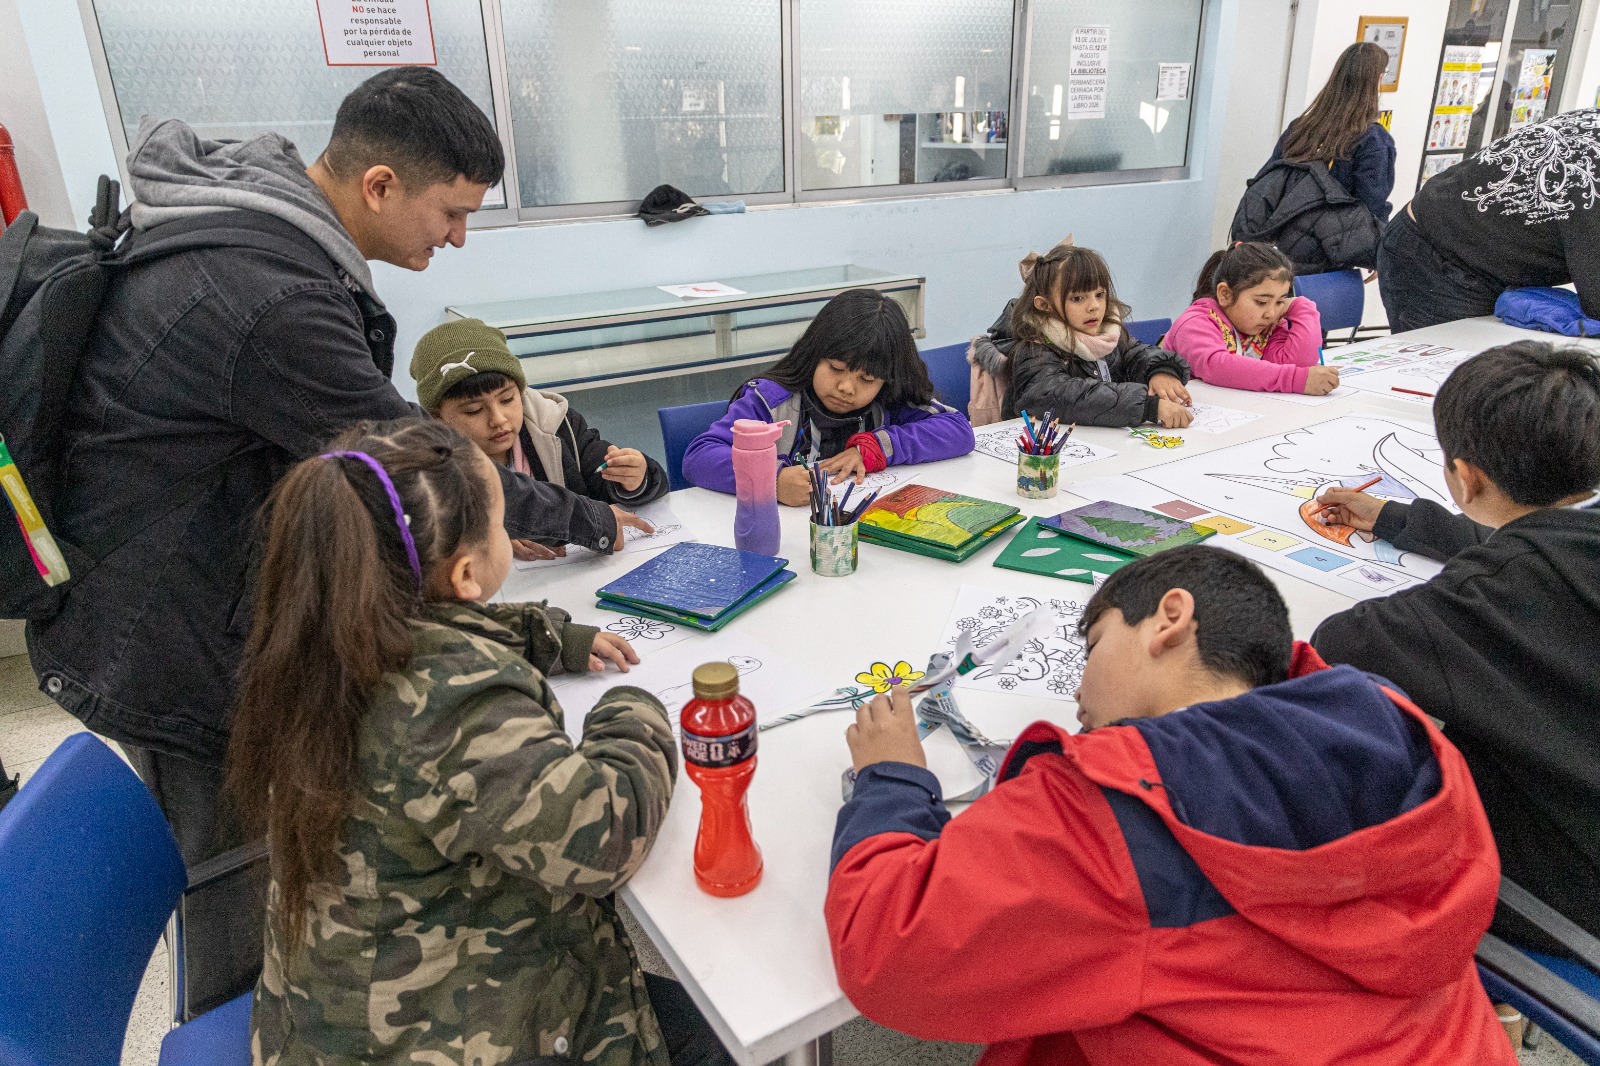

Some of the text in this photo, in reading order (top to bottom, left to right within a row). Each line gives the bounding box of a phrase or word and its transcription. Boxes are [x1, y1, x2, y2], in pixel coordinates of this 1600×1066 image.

[369, 27, 400, 36] pérdida
[346, 39, 412, 48] cualquier objeto
